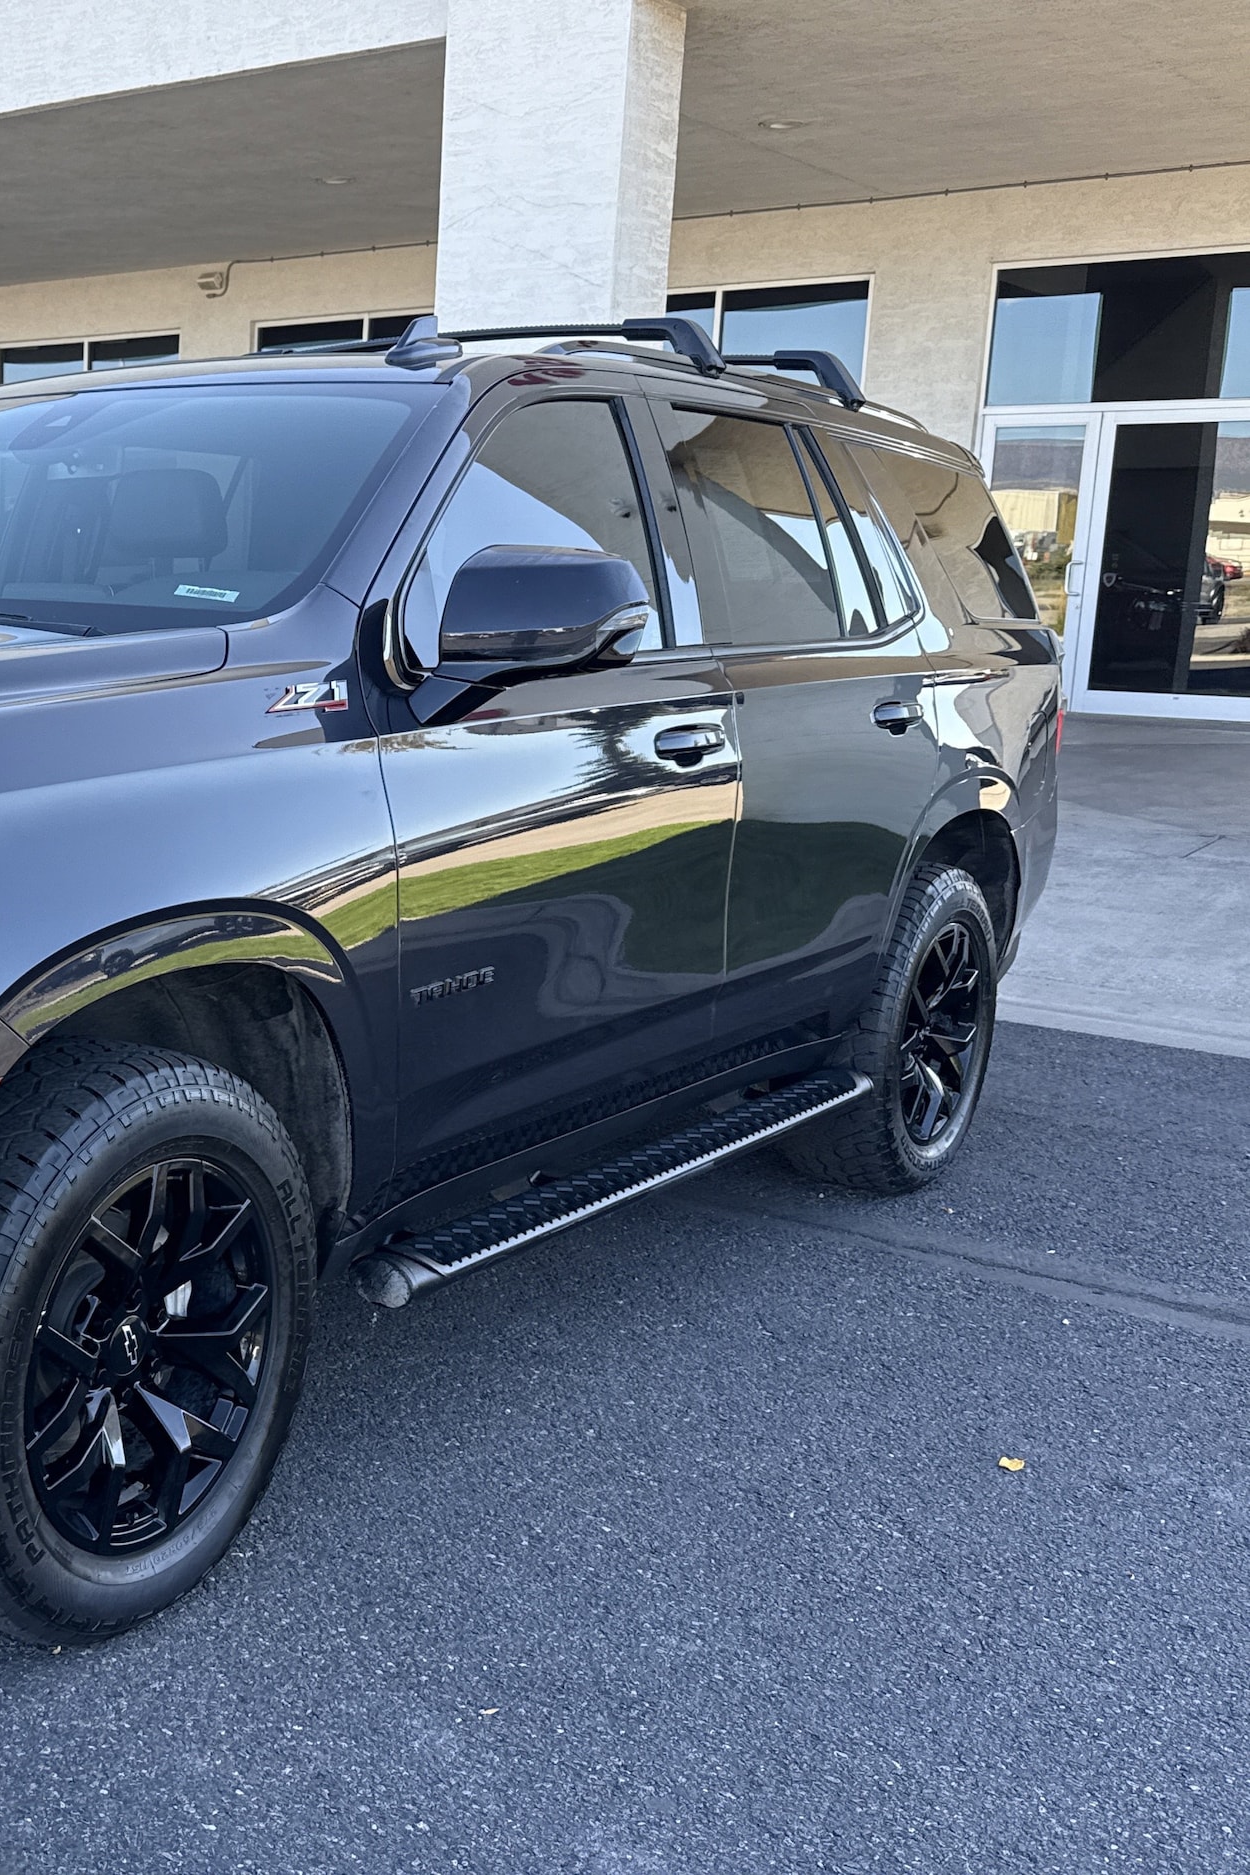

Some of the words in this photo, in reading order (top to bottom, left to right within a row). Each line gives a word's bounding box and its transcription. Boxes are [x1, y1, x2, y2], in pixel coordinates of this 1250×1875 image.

[265, 680, 348, 713] Z71
[410, 966, 495, 1007] TAHOE
[277, 1178, 302, 1235] ALL
